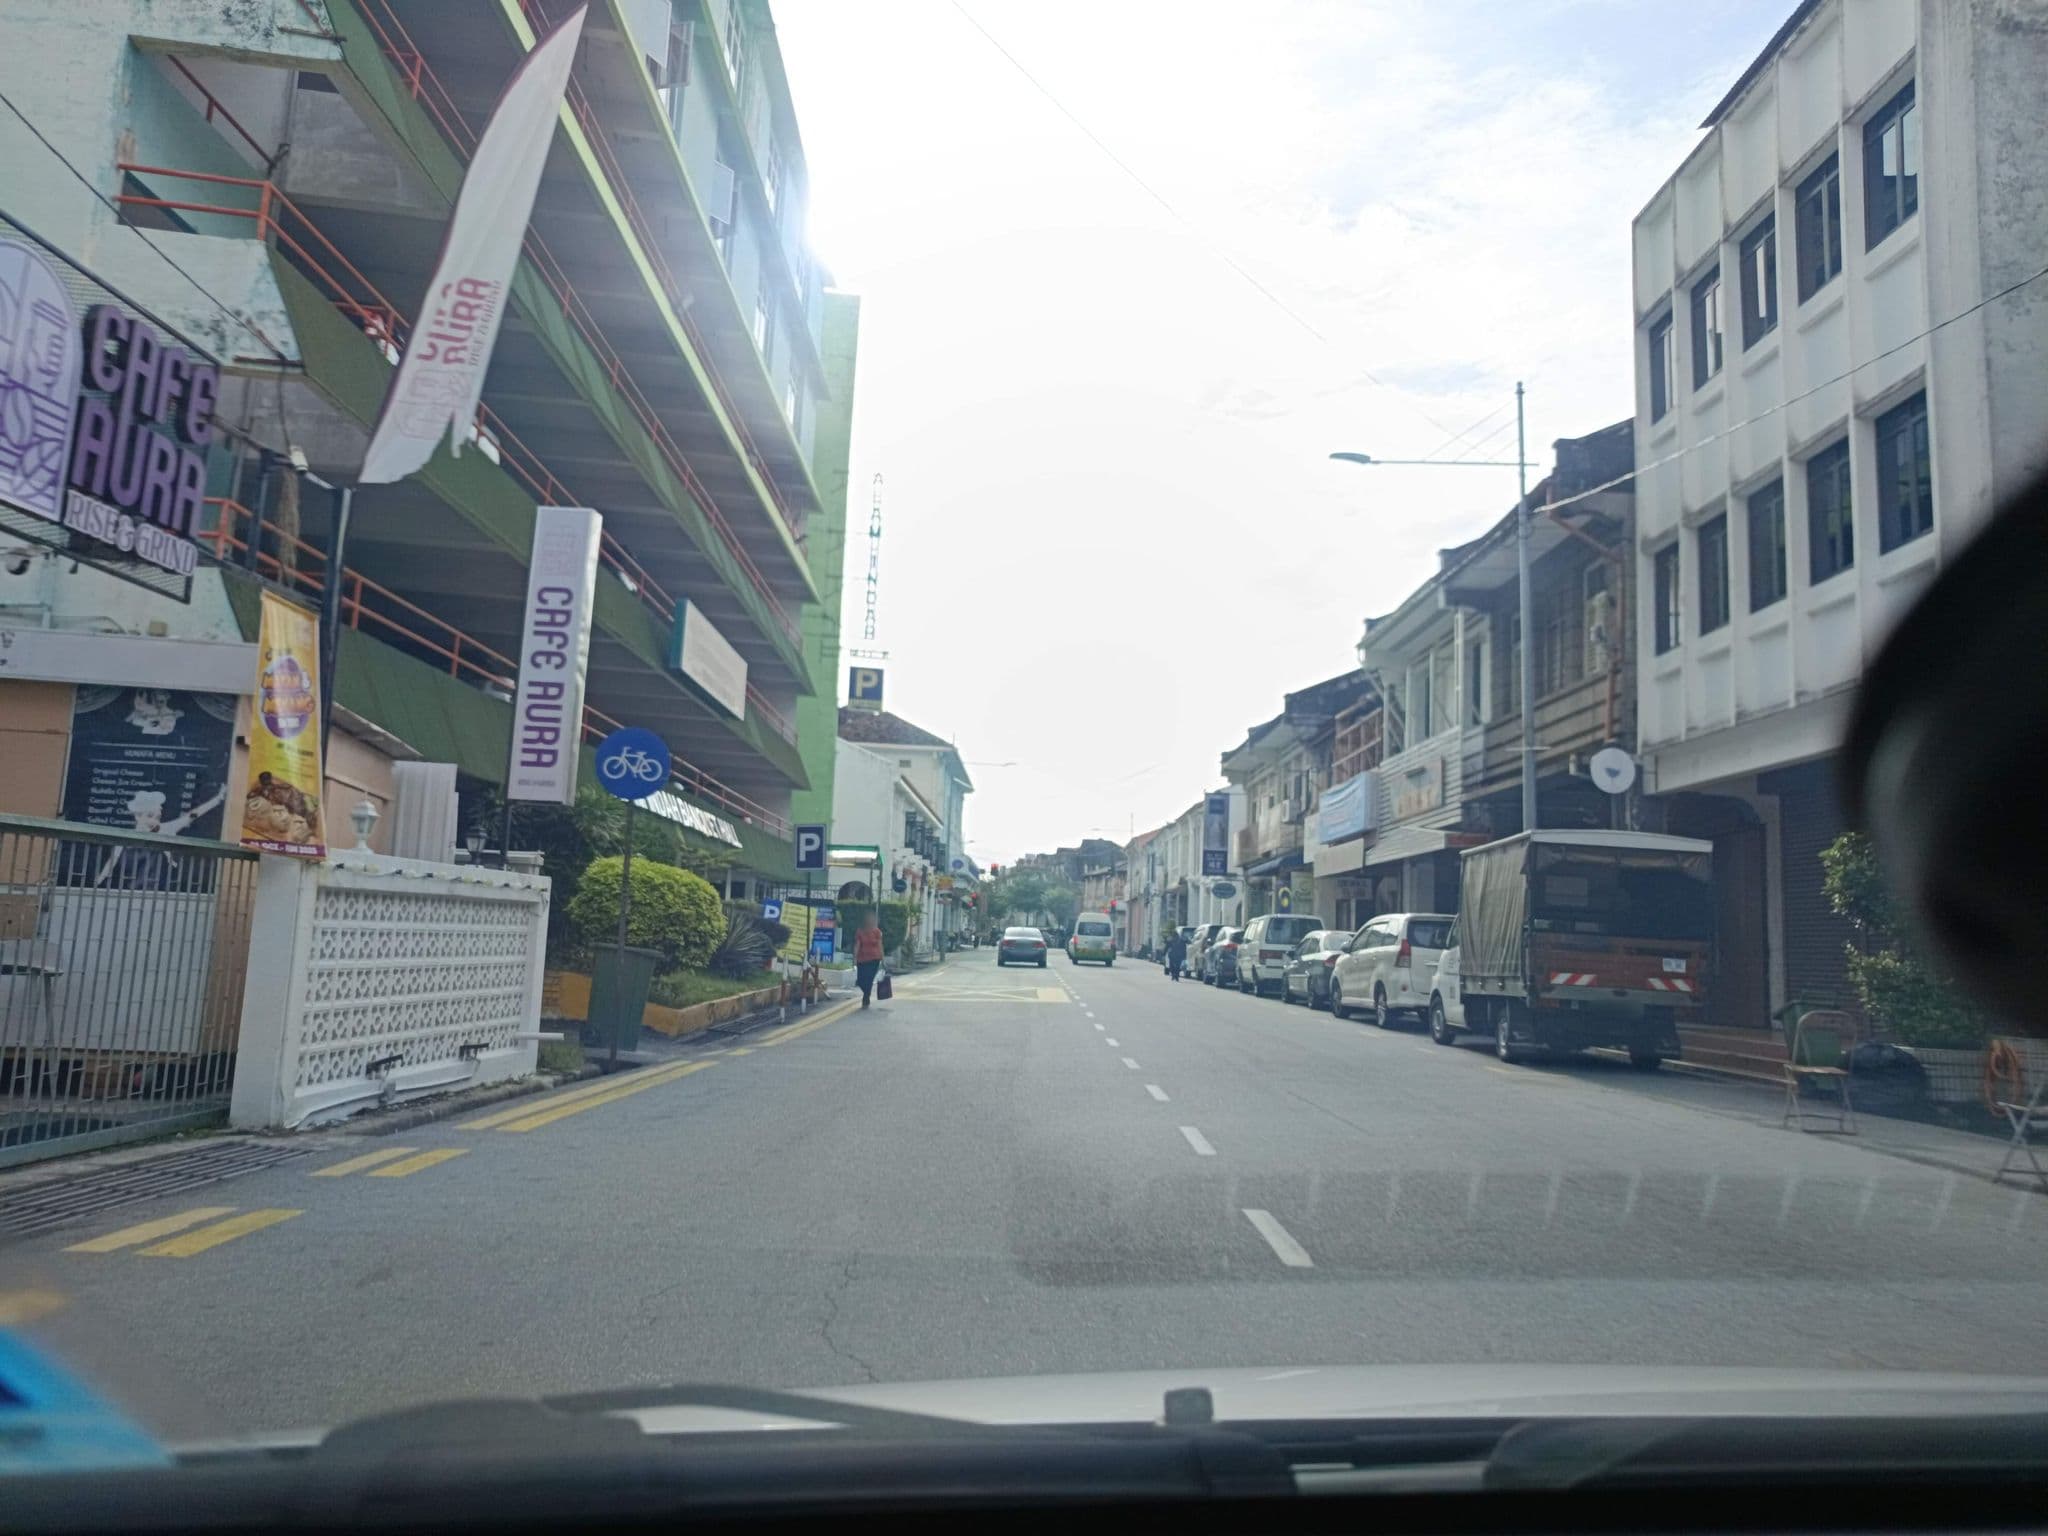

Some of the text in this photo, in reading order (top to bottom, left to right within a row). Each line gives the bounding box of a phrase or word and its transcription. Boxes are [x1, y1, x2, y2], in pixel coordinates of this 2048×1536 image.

[441, 276, 492, 365] AURA
[88, 304, 220, 446] CAFE
[70, 396, 208, 538] AURA
[134, 523, 199, 577] GRIND
[530, 586, 574, 670] CAFE
[520, 681, 565, 768] AURA
[856, 669, 879, 697] P
[799, 832, 820, 863] P
